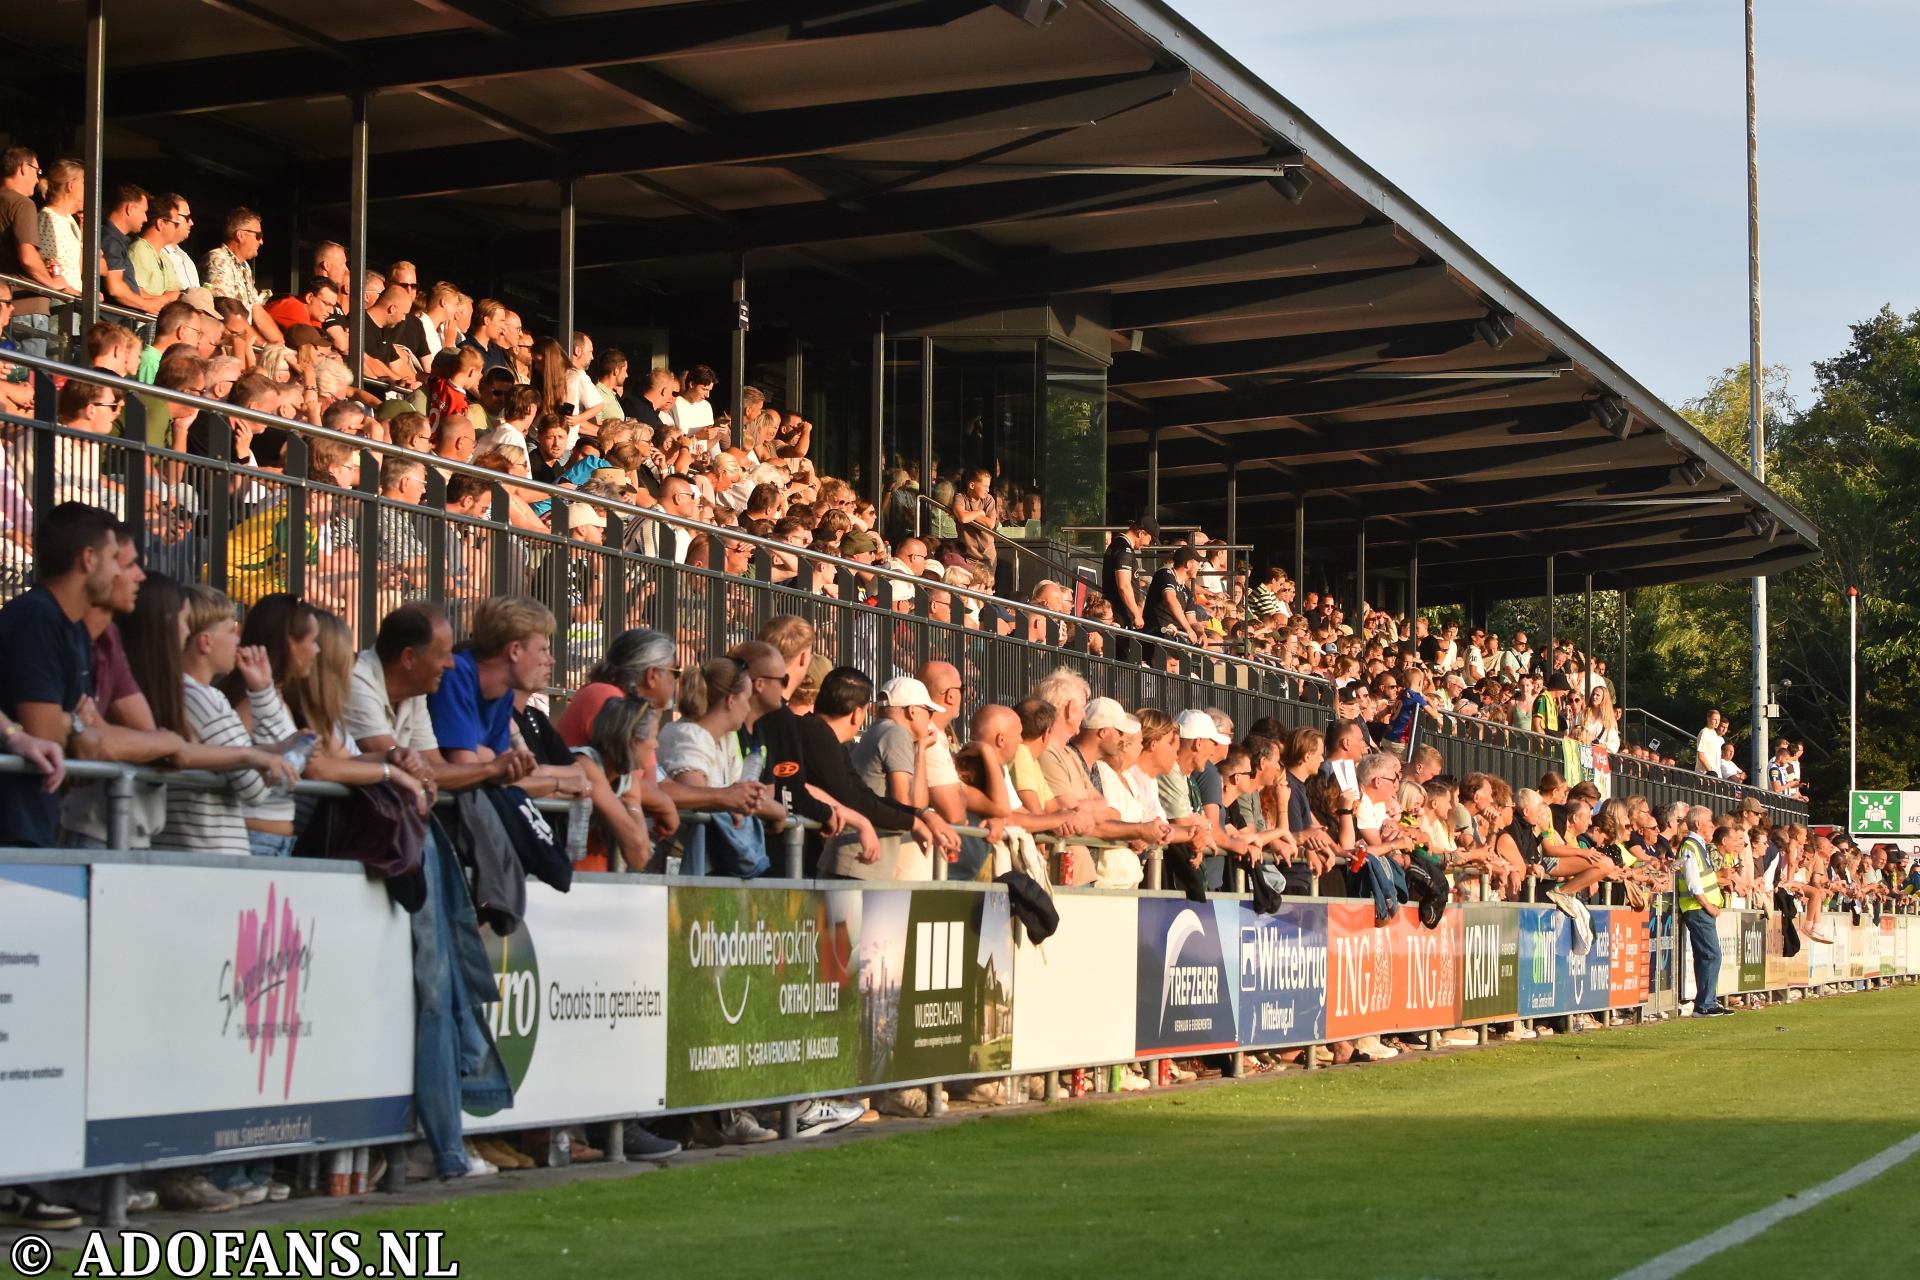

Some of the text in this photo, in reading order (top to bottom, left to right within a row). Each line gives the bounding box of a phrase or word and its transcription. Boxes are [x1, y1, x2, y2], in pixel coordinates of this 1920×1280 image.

[690, 919, 820, 984] Orthodontiepraktijk
[1258, 926, 1327, 1007] Wittebrug
[1335, 934, 1371, 1017] ING
[1406, 934, 1437, 1009] ING
[1464, 924, 1500, 1001] KRIJN
[549, 980, 662, 1030] Groots in genieten
[779, 981, 840, 1015] ORTHO BILLET
[1169, 966, 1219, 1006] TREFZEKER
[1261, 1000, 1295, 1037] Wittebrug.nl
[689, 1044, 739, 1072] VLAARDINGEN
[806, 1036, 839, 1060] MAASSLUIS
